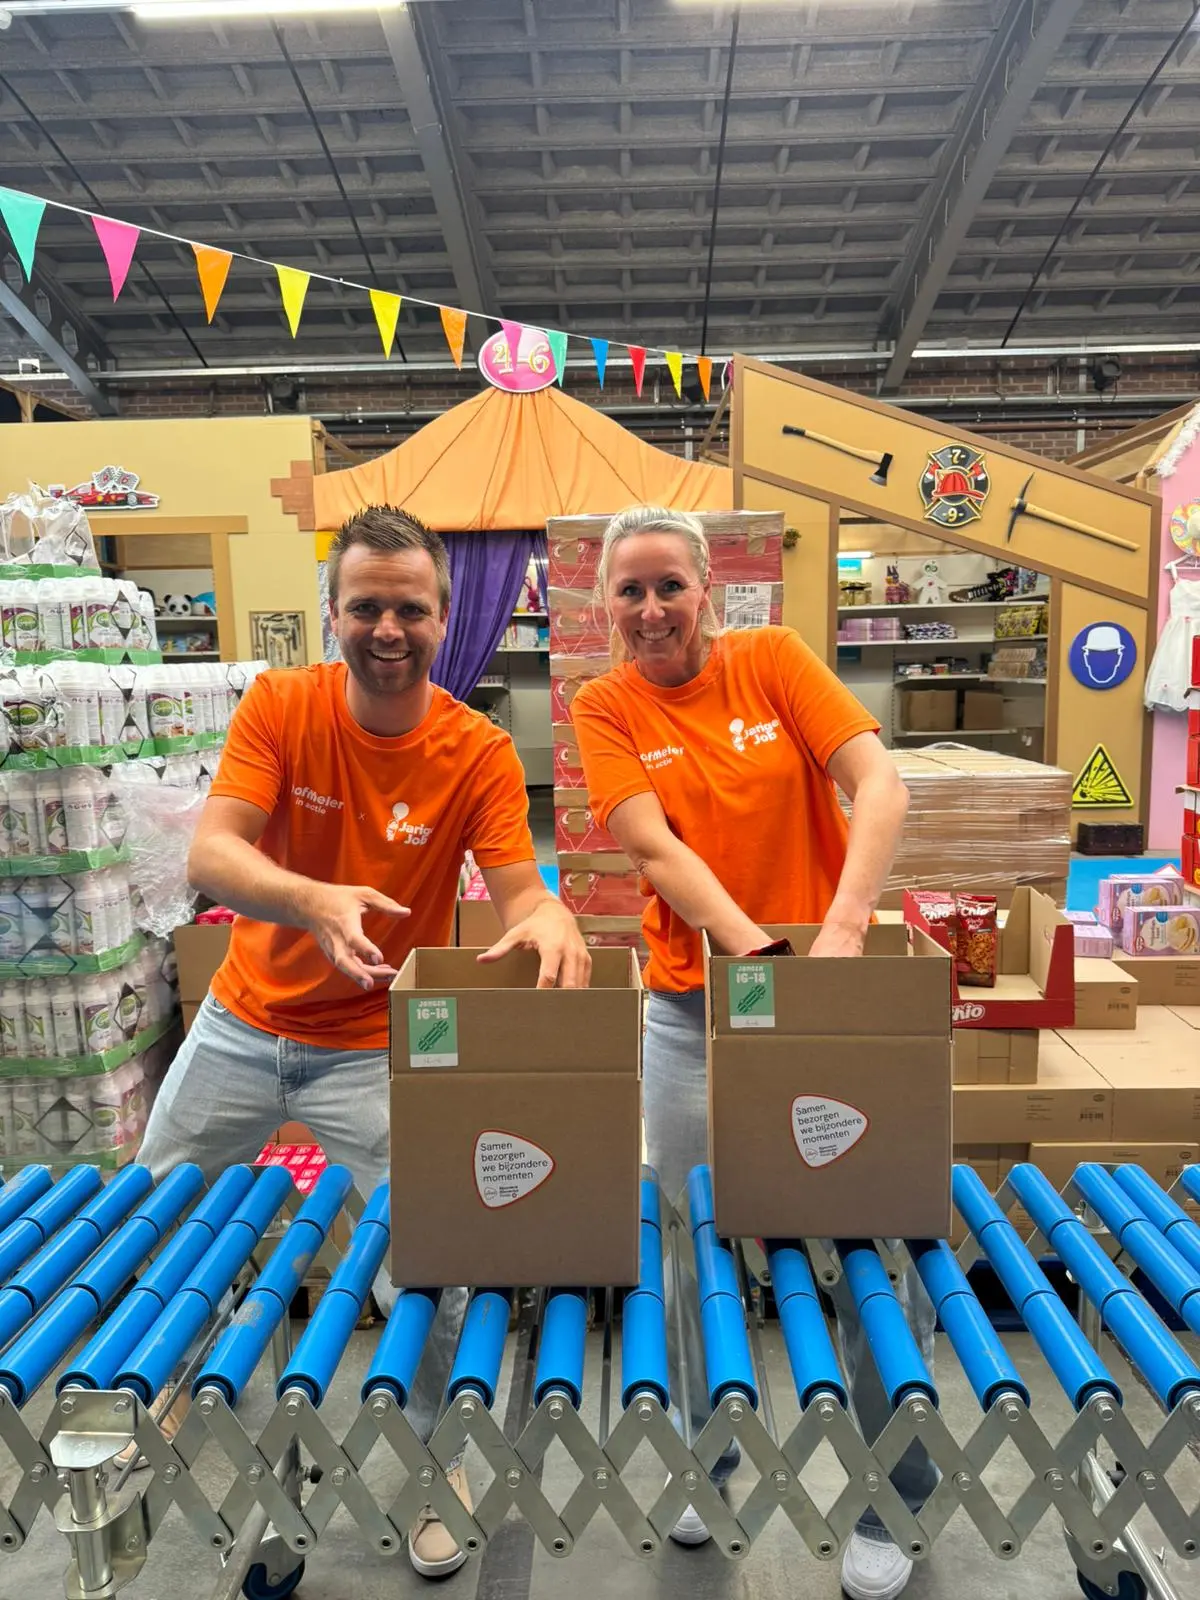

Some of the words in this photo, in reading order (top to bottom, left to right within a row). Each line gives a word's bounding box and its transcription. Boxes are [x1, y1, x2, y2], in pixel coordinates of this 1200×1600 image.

[754, 730, 778, 745] Job
[295, 797, 304, 807] in
[404, 833, 428, 846] Job
[736, 972, 766, 984] 16-18
[416, 1008, 449, 1020] 16-18
[952, 1004, 984, 1021] hio
[795, 1103, 826, 1116] Samen
[797, 1111, 840, 1126] bezorgen
[800, 1126, 813, 1135] we
[815, 1117, 863, 1133] bijzondere
[802, 1129, 850, 1145] momenten
[480, 1142, 513, 1152] Samen
[481, 1151, 526, 1163] bezorgen
[482, 1164, 496, 1173] we
[498, 1159, 549, 1173] bijzondere
[483, 1172, 534, 1183] momenten
